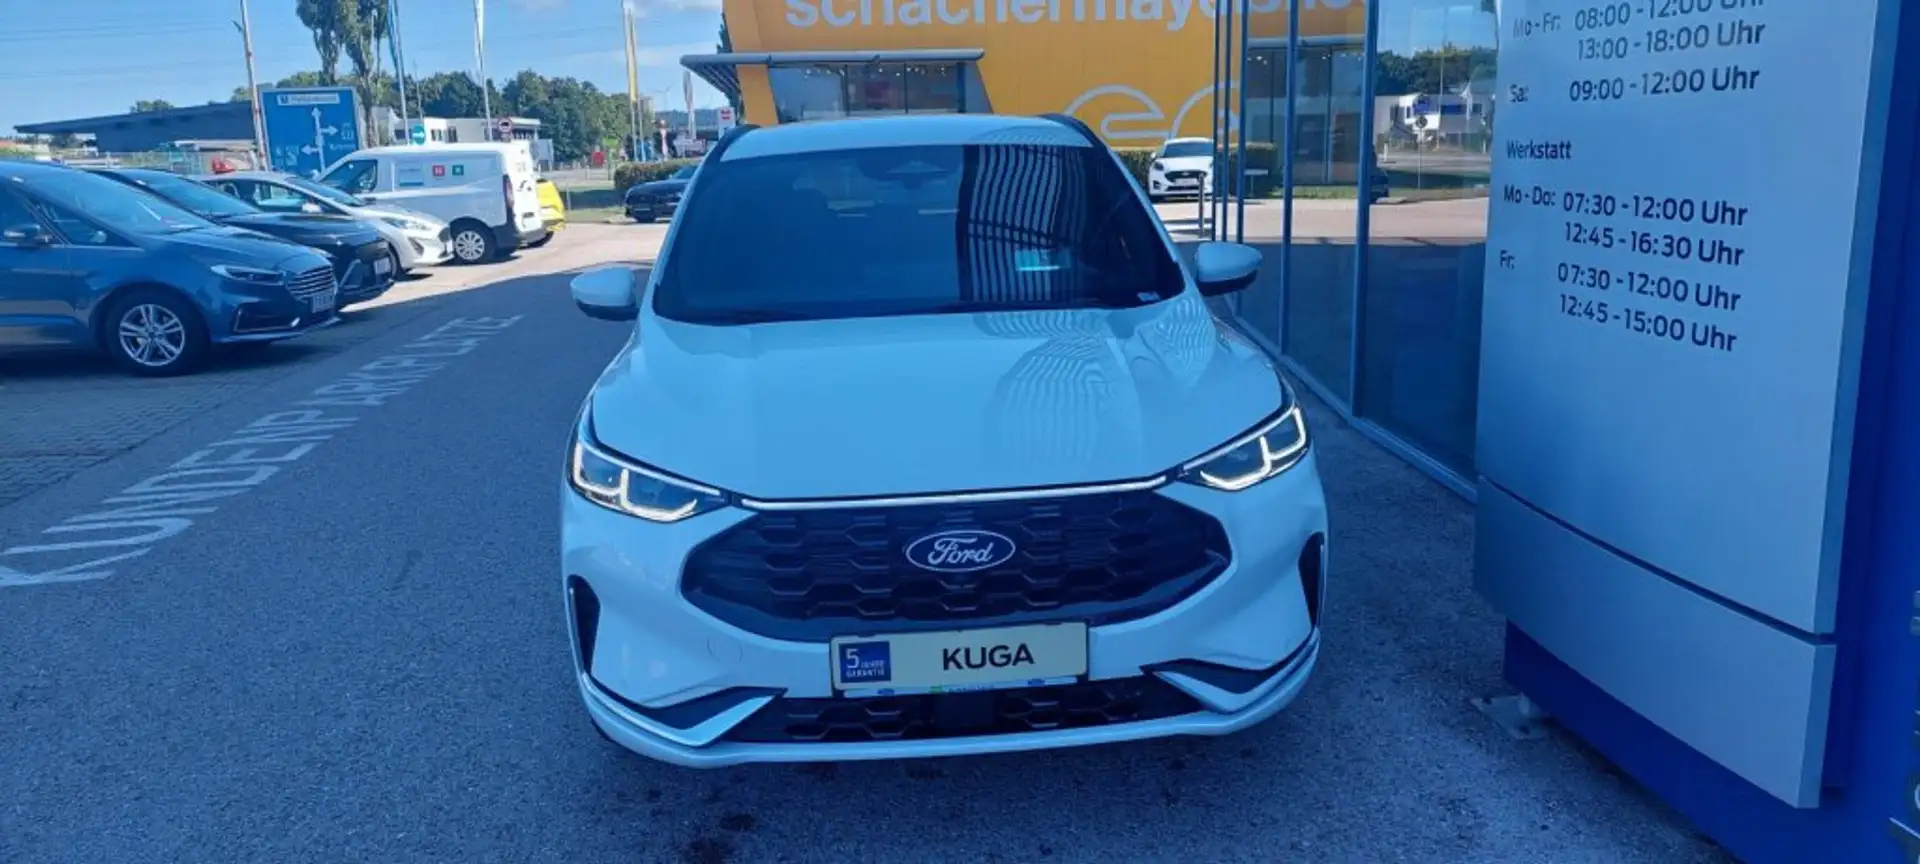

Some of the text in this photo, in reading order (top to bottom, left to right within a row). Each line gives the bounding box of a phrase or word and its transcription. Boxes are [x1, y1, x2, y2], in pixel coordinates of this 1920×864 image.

[1717, 19, 1766, 46] Uhr
[1510, 84, 1528, 102] Sa:
[1712, 65, 1759, 91] Uhr
[1507, 140, 1571, 160] Werkstatt
[1702, 200, 1748, 226] Uhr
[1698, 239, 1744, 266] Uhr
[1499, 250, 1515, 270] Fr:
[1695, 283, 1741, 311] Uhr
[1691, 322, 1737, 351] Uhr
[928, 536, 995, 565] Ford
[846, 648, 861, 669] 5
[942, 643, 1035, 671] KUGA
